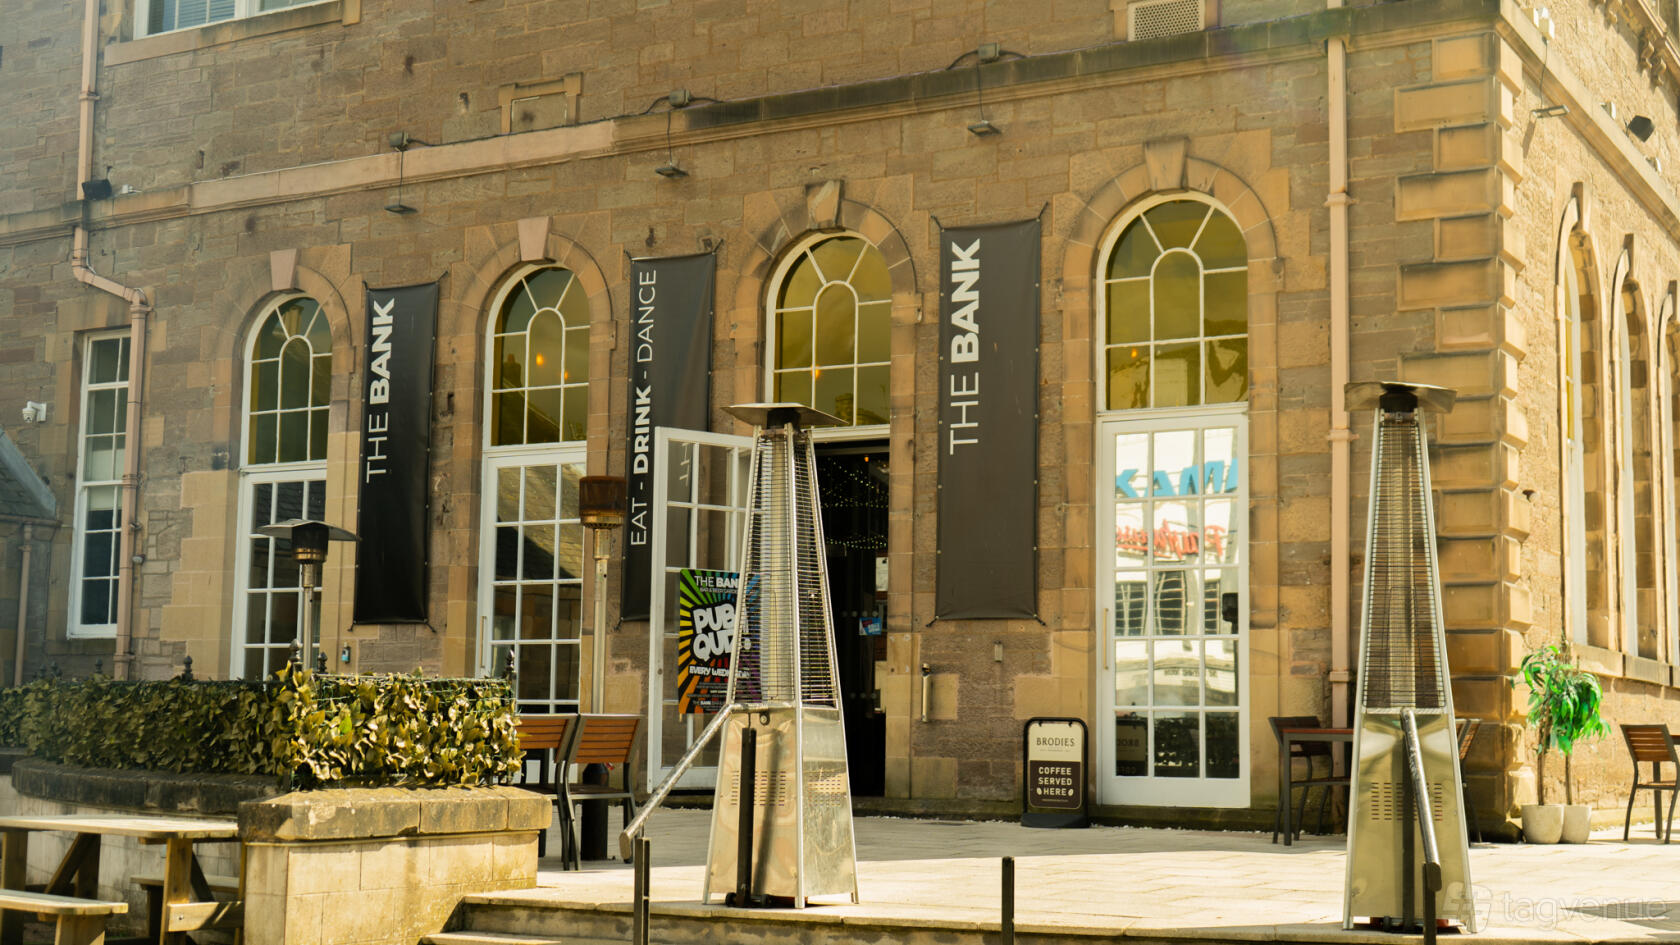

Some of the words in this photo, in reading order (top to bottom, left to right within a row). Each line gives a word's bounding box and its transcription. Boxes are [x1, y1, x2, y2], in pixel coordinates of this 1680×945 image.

[637, 270, 657, 362] DANCE
[951, 238, 980, 363] BANK
[369, 298, 395, 404] BANK
[633, 385, 651, 475] DRINK
[949, 372, 979, 455] THE
[366, 412, 389, 484] THE
[630, 497, 647, 545] EAT
[694, 575, 714, 588] THE
[715, 577, 738, 588] BAN
[693, 603, 735, 634] PUB
[689, 665, 711, 676] EVERY
[1036, 737, 1075, 747] BRODIES
[1038, 767, 1072, 775] COFFEE
[1038, 777, 1072, 786] SERVED
[1043, 788, 1067, 796] HERE
